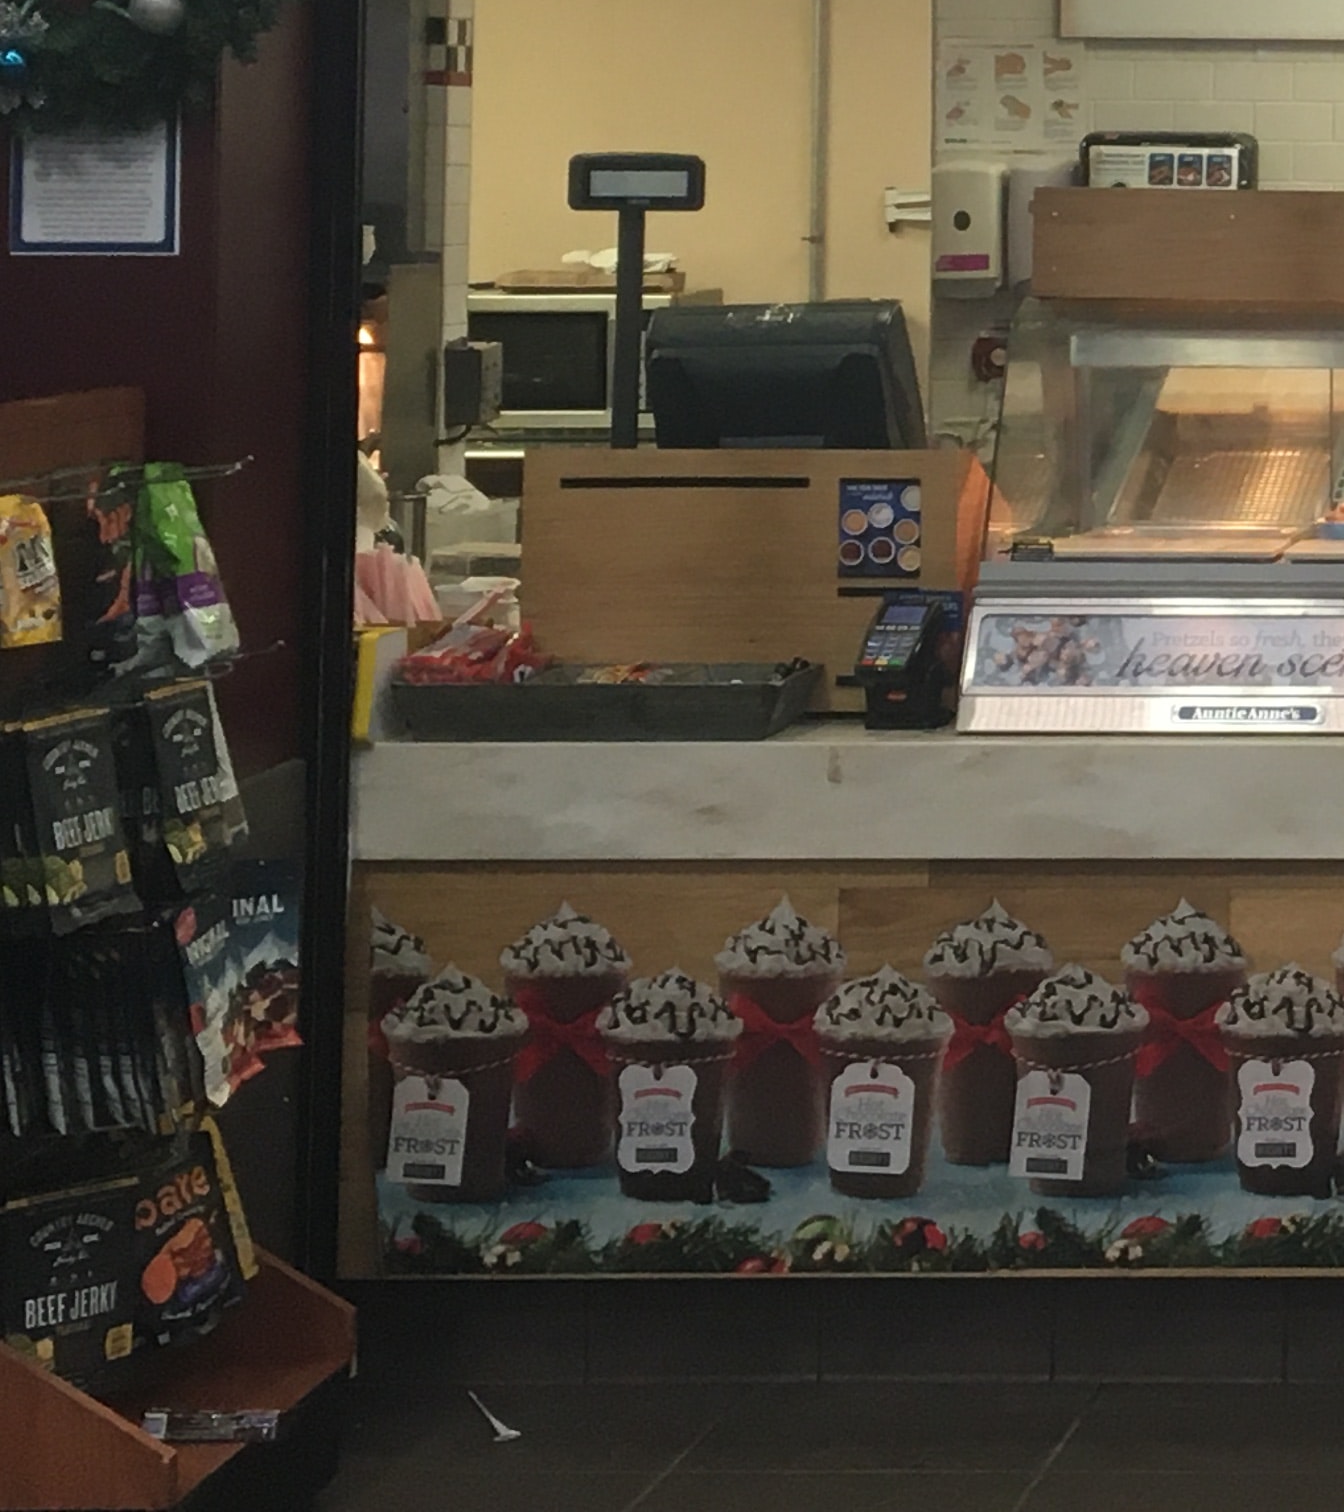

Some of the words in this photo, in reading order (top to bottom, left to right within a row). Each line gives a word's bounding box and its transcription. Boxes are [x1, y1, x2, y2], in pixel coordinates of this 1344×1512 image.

[1114, 635, 1266, 678] heaven
[1151, 630, 1224, 649] Pretzels
[1228, 635, 1251, 649] so
[24, 1292, 68, 1329] BEEF
[69, 1279, 119, 1321] JERKY
